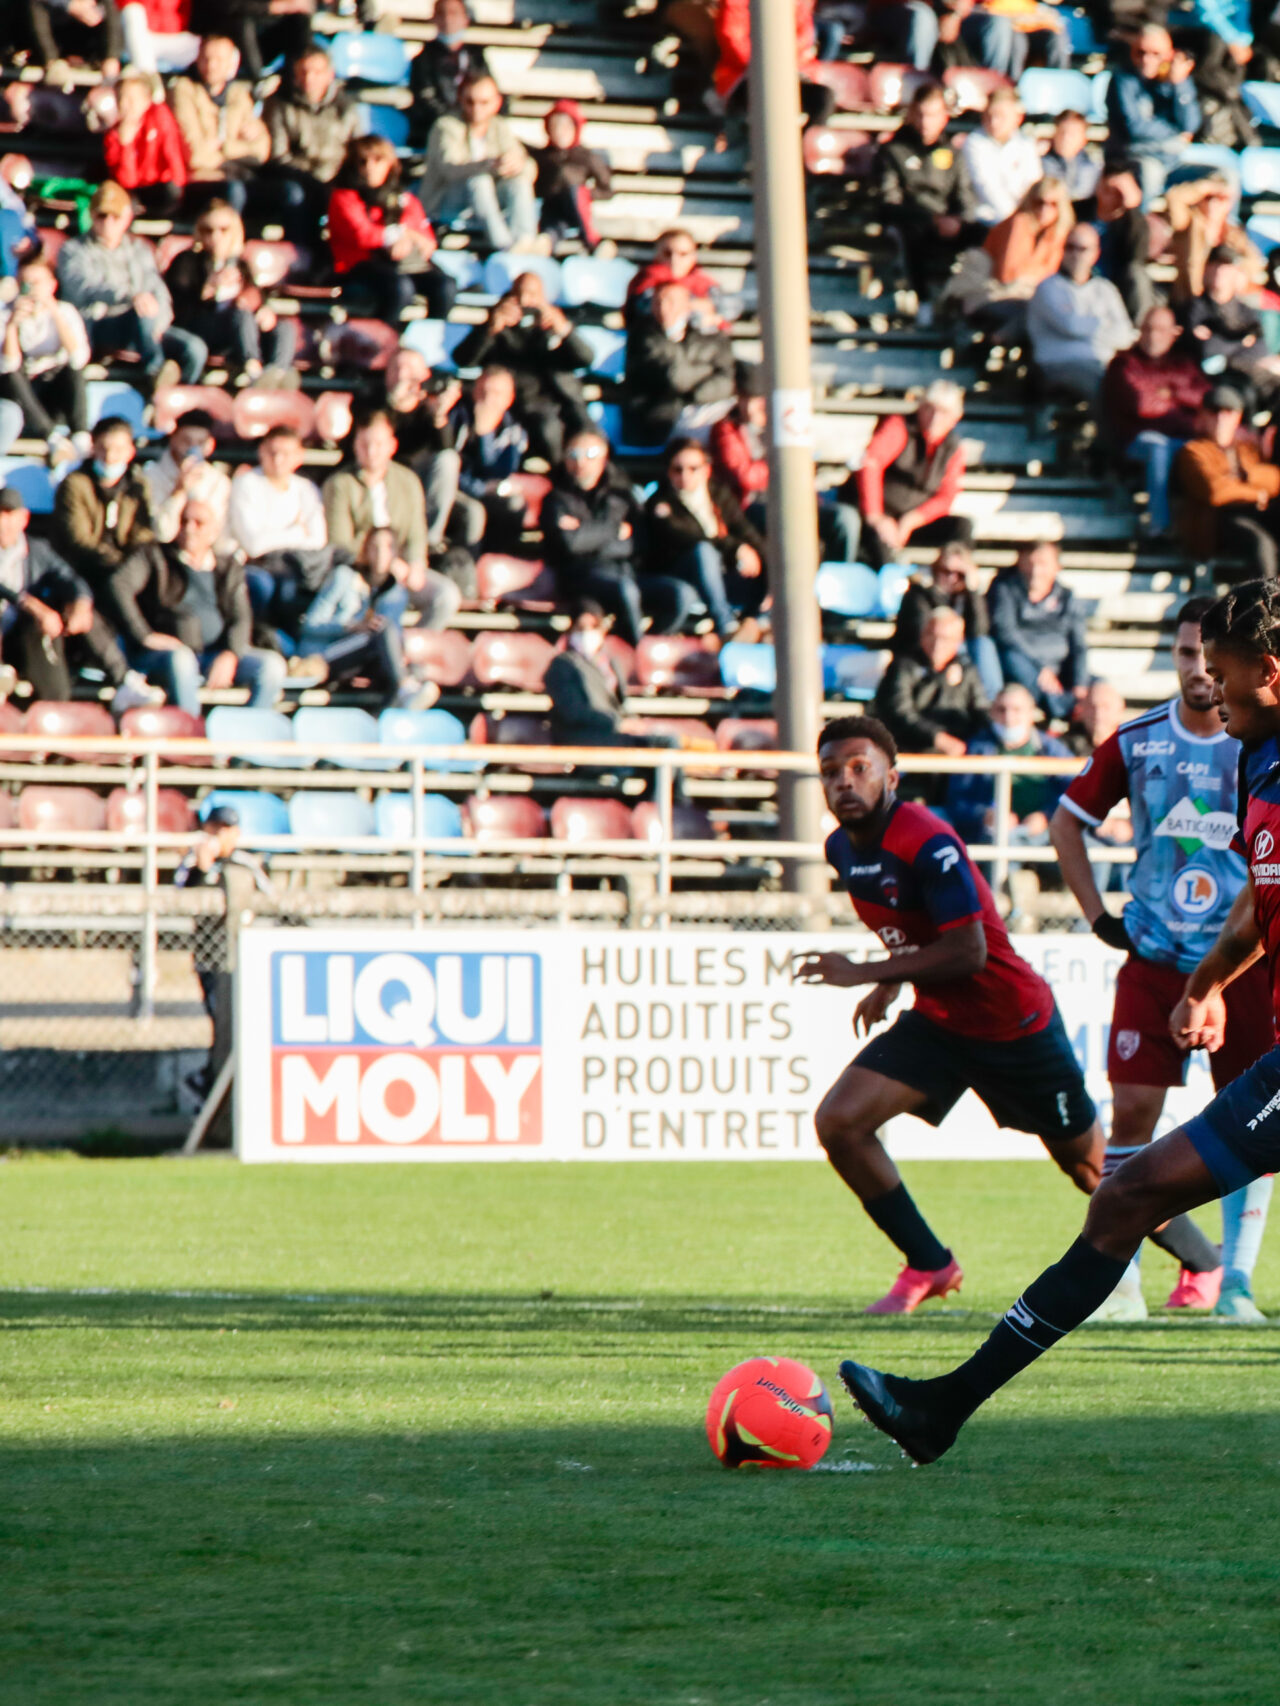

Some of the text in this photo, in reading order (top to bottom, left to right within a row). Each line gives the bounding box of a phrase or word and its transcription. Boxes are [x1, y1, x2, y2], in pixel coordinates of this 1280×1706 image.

[581, 947, 747, 986] HUILES
[279, 953, 533, 1048] LIQUI
[580, 1002, 793, 1041] ADDITIFS
[581, 1056, 811, 1096] PRODUITS
[279, 1053, 541, 1145] MOLY
[581, 1106, 808, 1150] D'ENTRET
